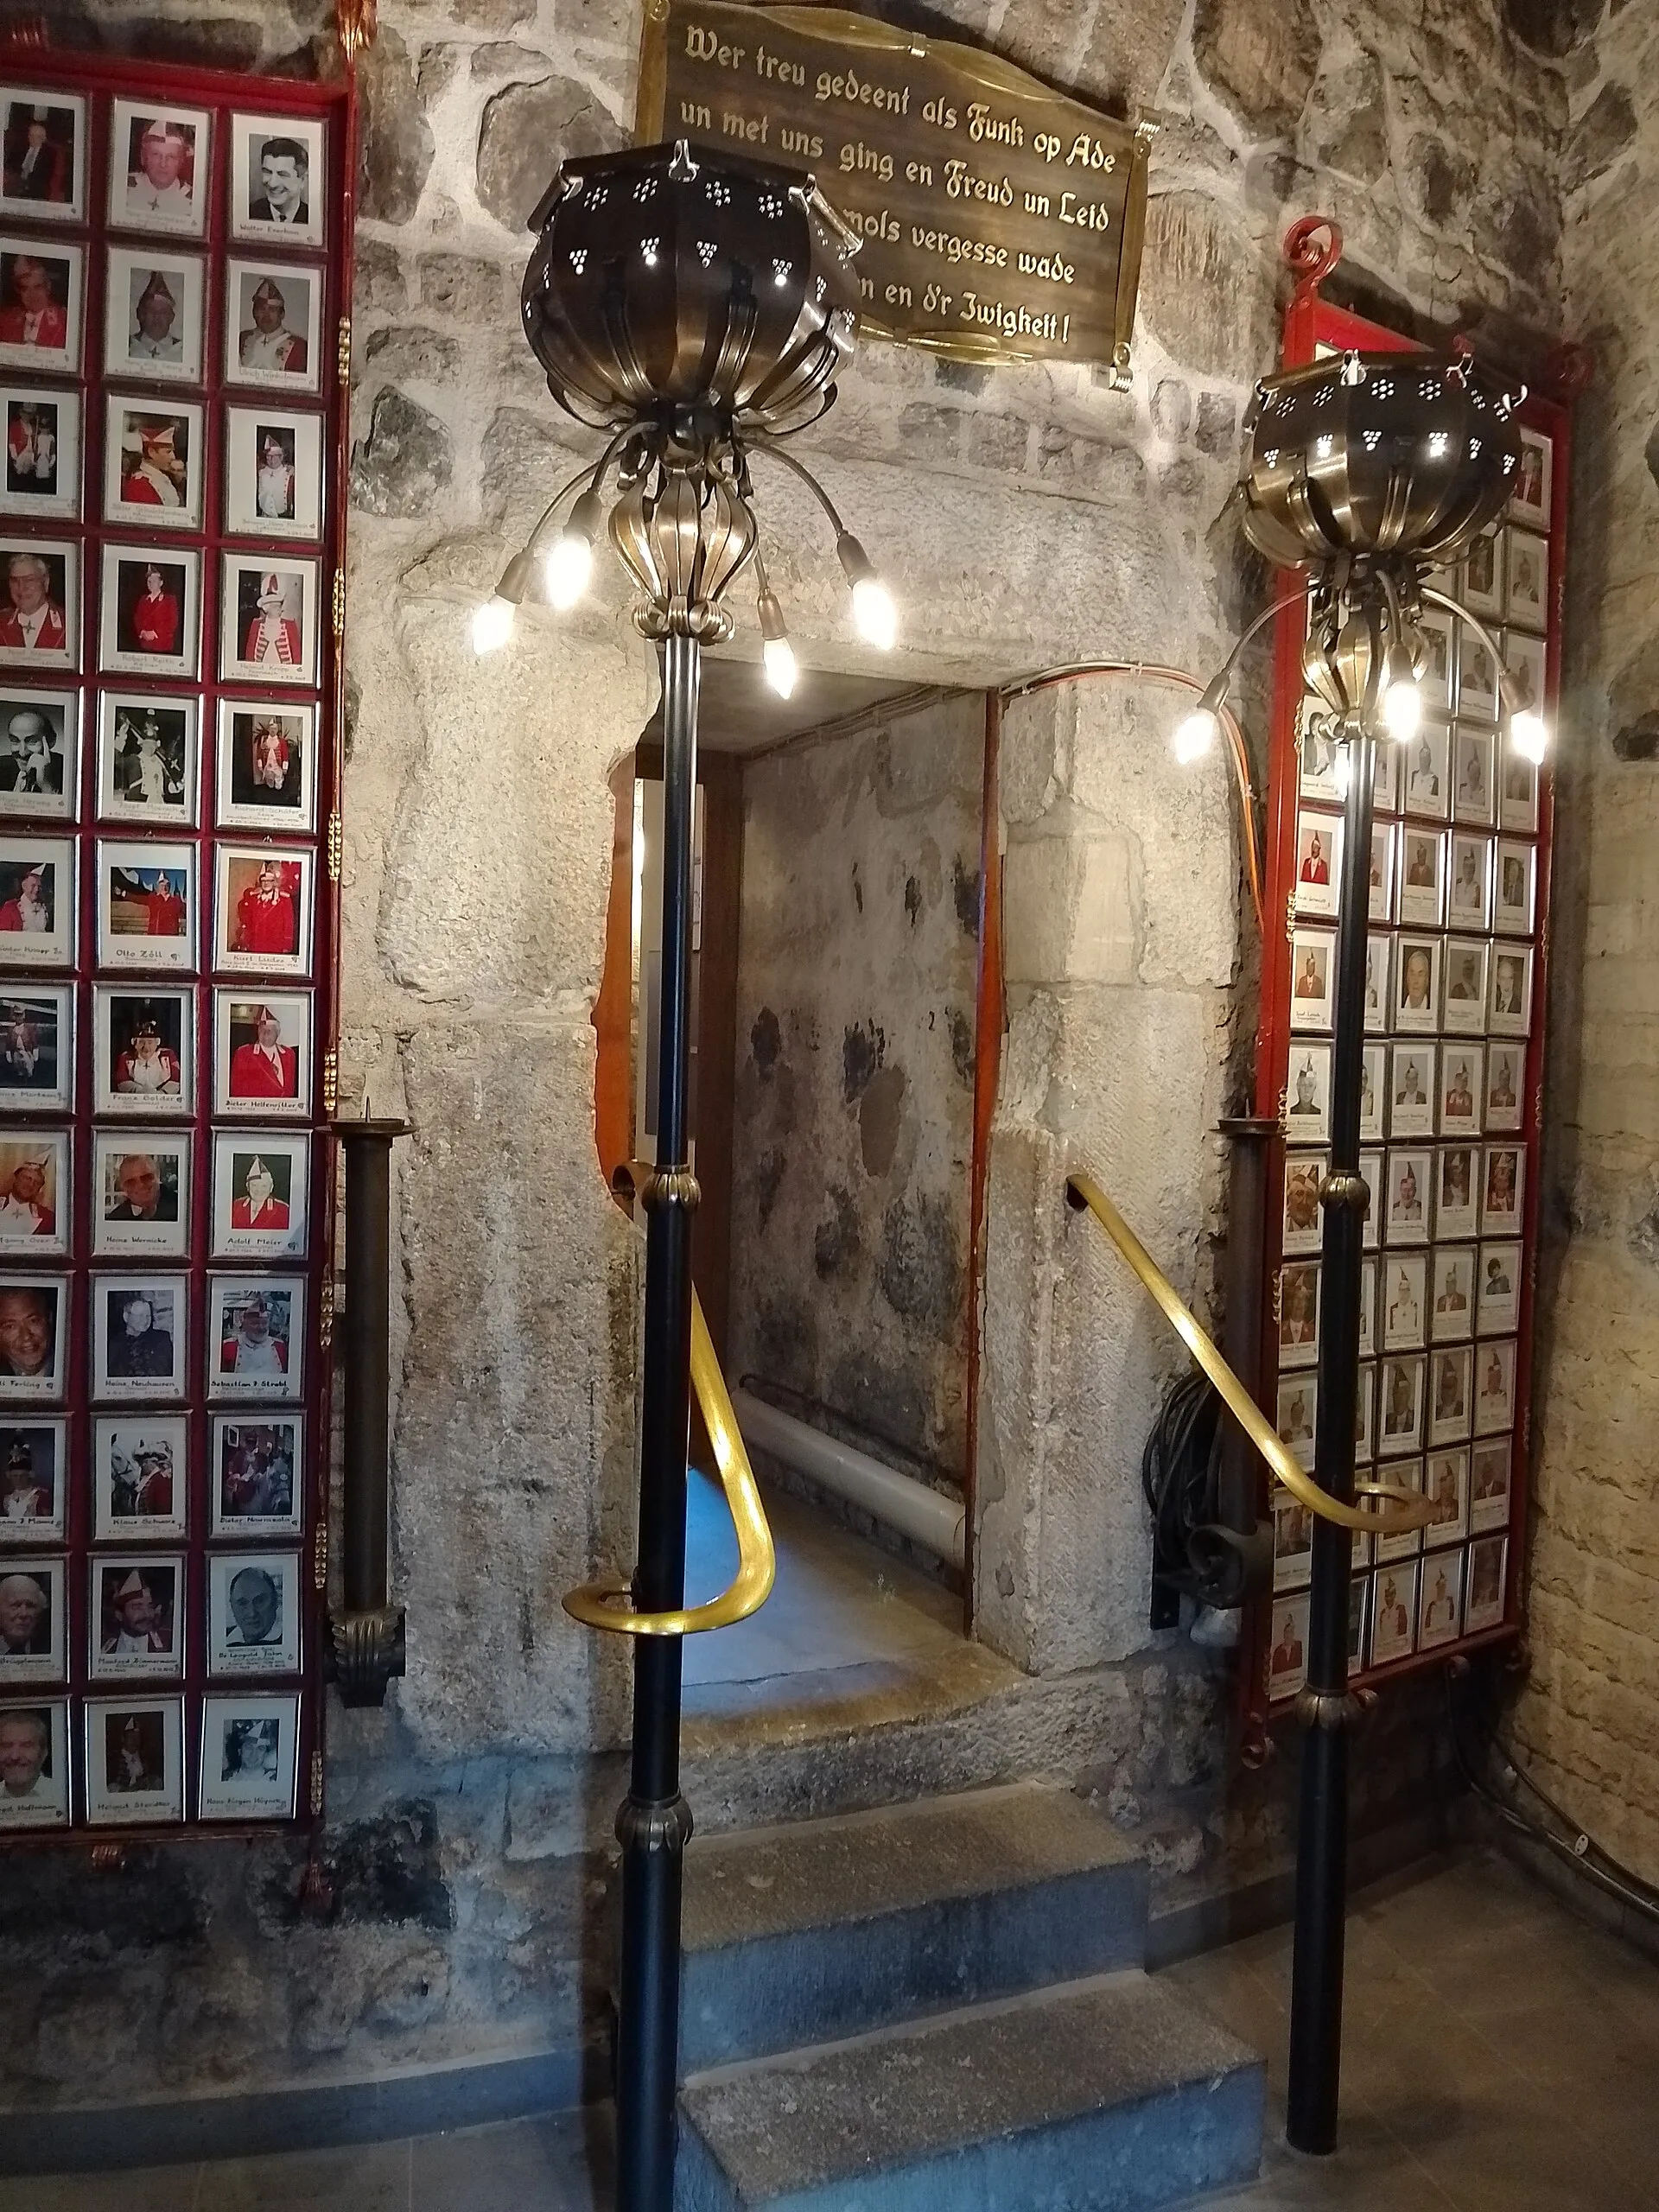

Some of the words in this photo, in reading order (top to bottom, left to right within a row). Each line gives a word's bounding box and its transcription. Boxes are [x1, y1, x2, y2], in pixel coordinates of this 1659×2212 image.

[685, 24, 746, 69] Wer
[756, 46, 805, 86] treu
[815, 69, 910, 114] gedeent
[922, 97, 958, 130] als
[967, 102, 1025, 148] Funk
[1033, 133, 1061, 162] op
[681, 102, 711, 130] un
[723, 111, 769, 143] met
[780, 129, 823, 157] uns
[839, 141, 893, 182] ging
[906, 161, 933, 187] en
[944, 159, 1014, 207] Freud
[1024, 192, 1050, 217] un
[1058, 191, 1109, 232] Leid
[911, 225, 1008, 268] vergesse
[1018, 251, 1076, 284] wade
[857, 277, 874, 300] n
[886, 283, 912, 308] en
[116, 950, 135, 958] Otto
